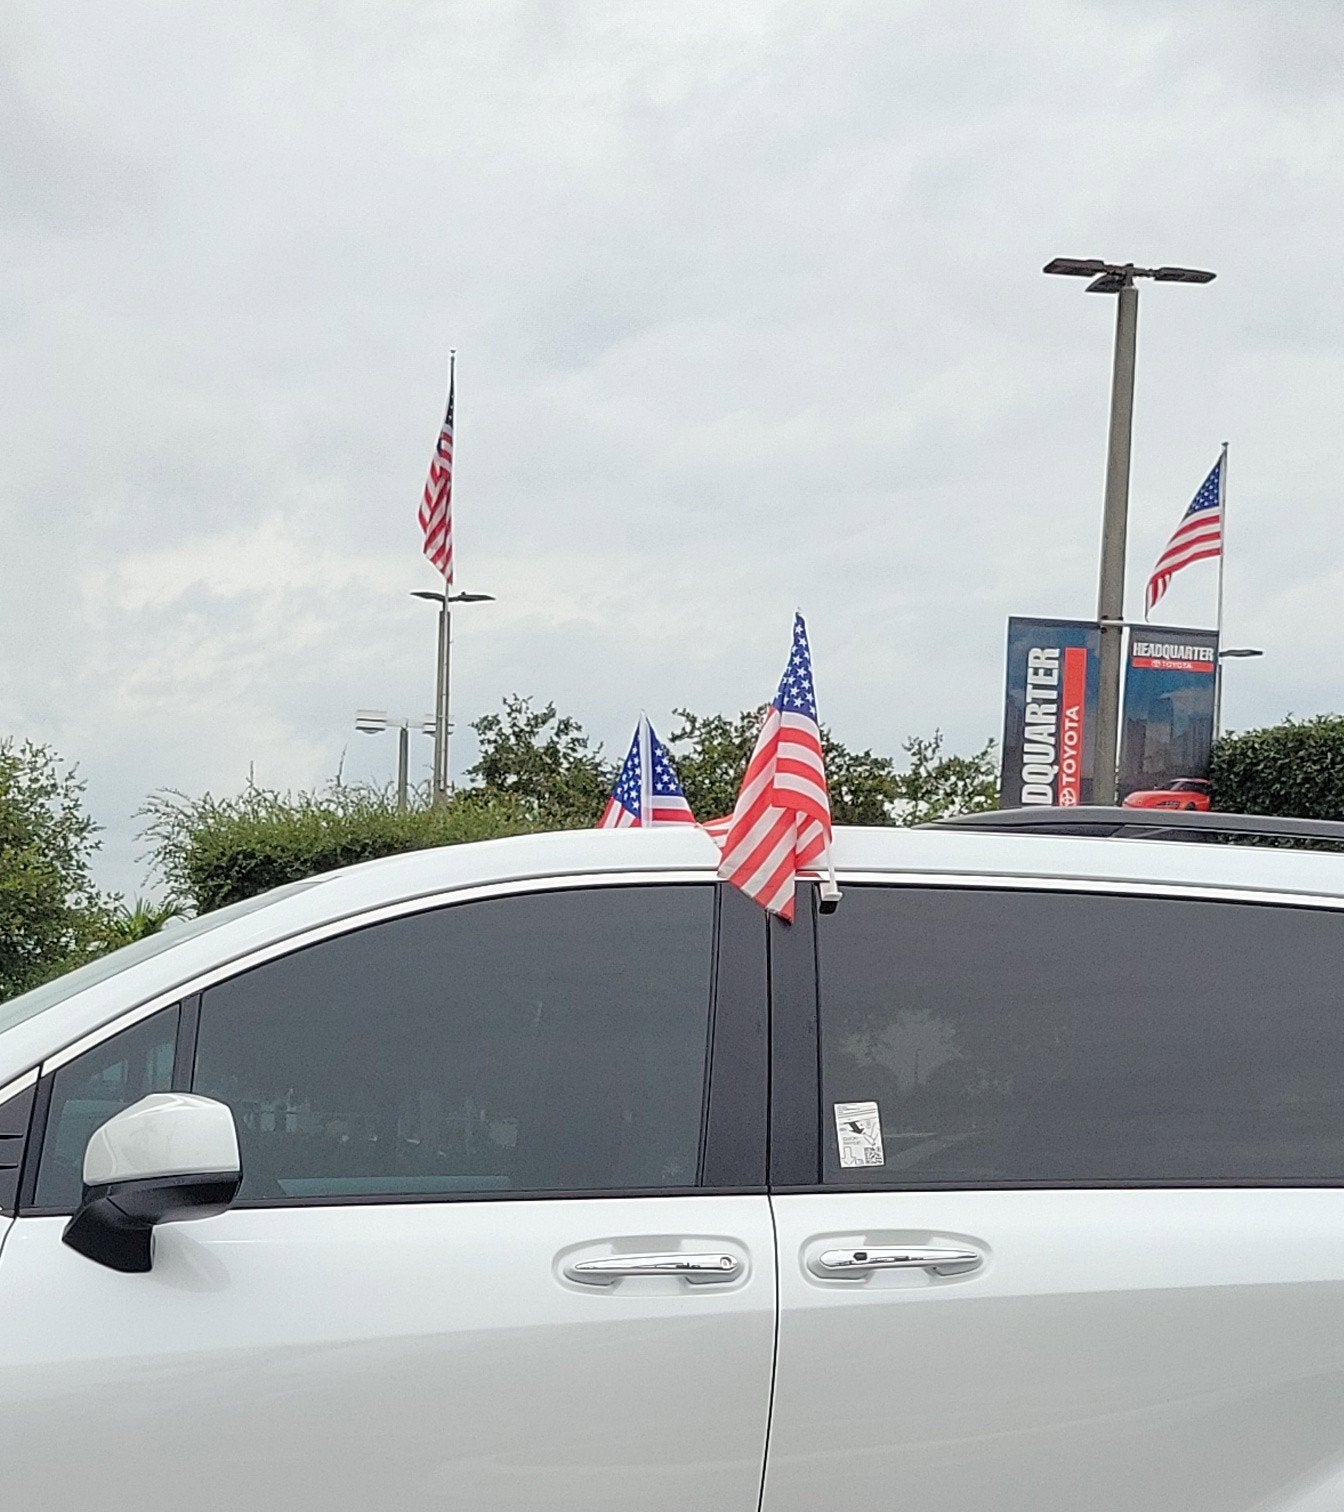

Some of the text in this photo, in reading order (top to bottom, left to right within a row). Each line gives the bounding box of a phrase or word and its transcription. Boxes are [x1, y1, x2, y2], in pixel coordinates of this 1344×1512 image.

[1132, 641, 1215, 662] HEADQUARTER
[1162, 660, 1194, 669] TOYOTA
[1061, 705, 1081, 786] TOYOTA
